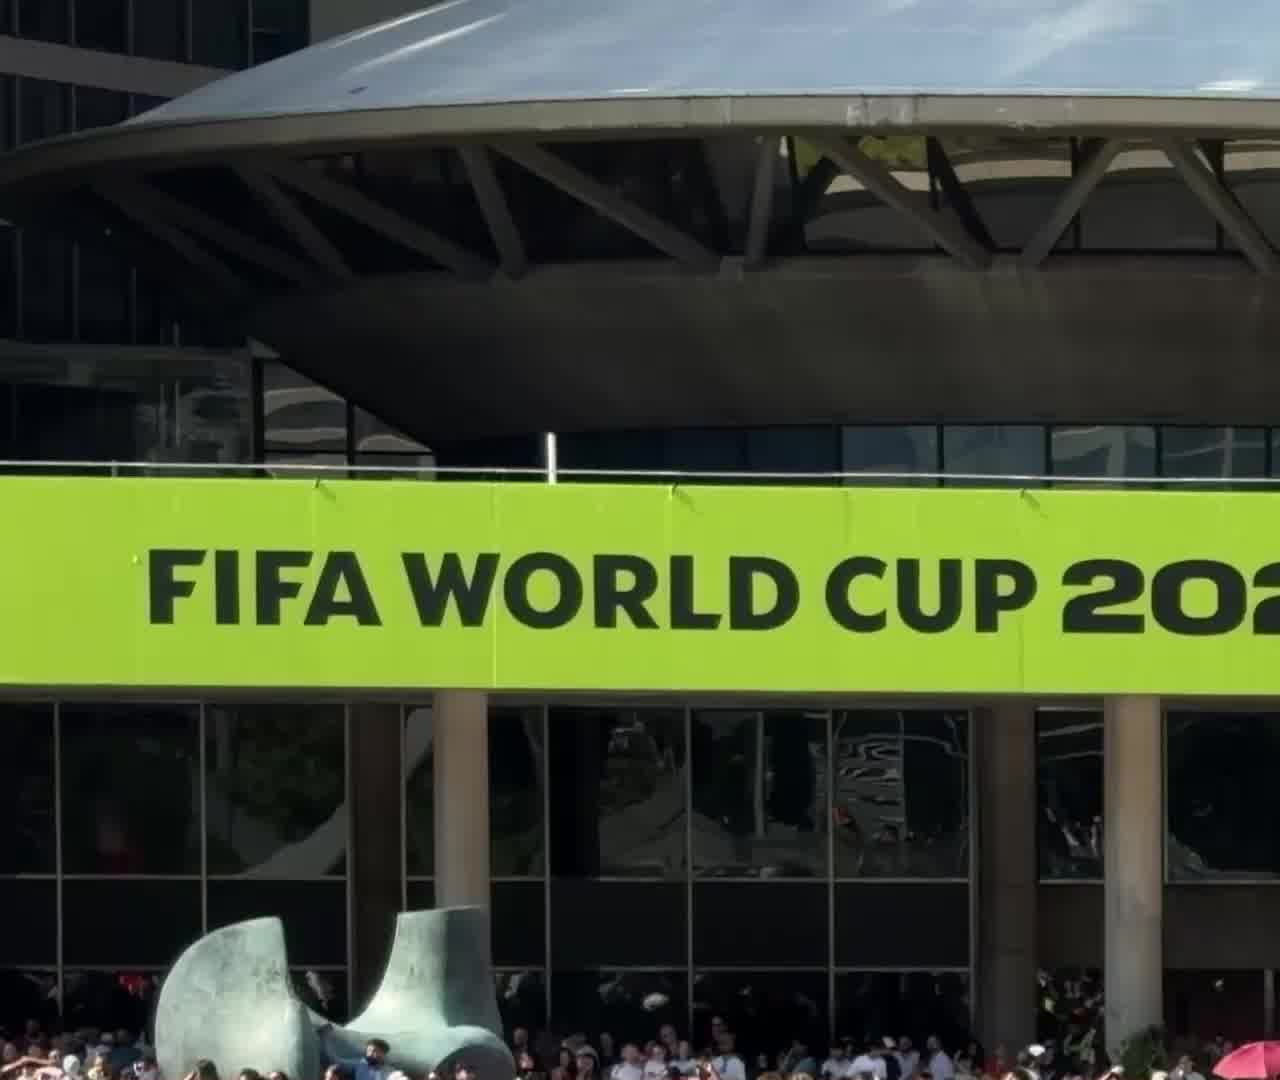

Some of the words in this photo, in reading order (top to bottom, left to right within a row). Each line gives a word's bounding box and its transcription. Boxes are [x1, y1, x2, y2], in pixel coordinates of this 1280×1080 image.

[149, 550, 381, 625] FIFA
[402, 553, 799, 630] WORLD
[826, 557, 1036, 633] CUP
